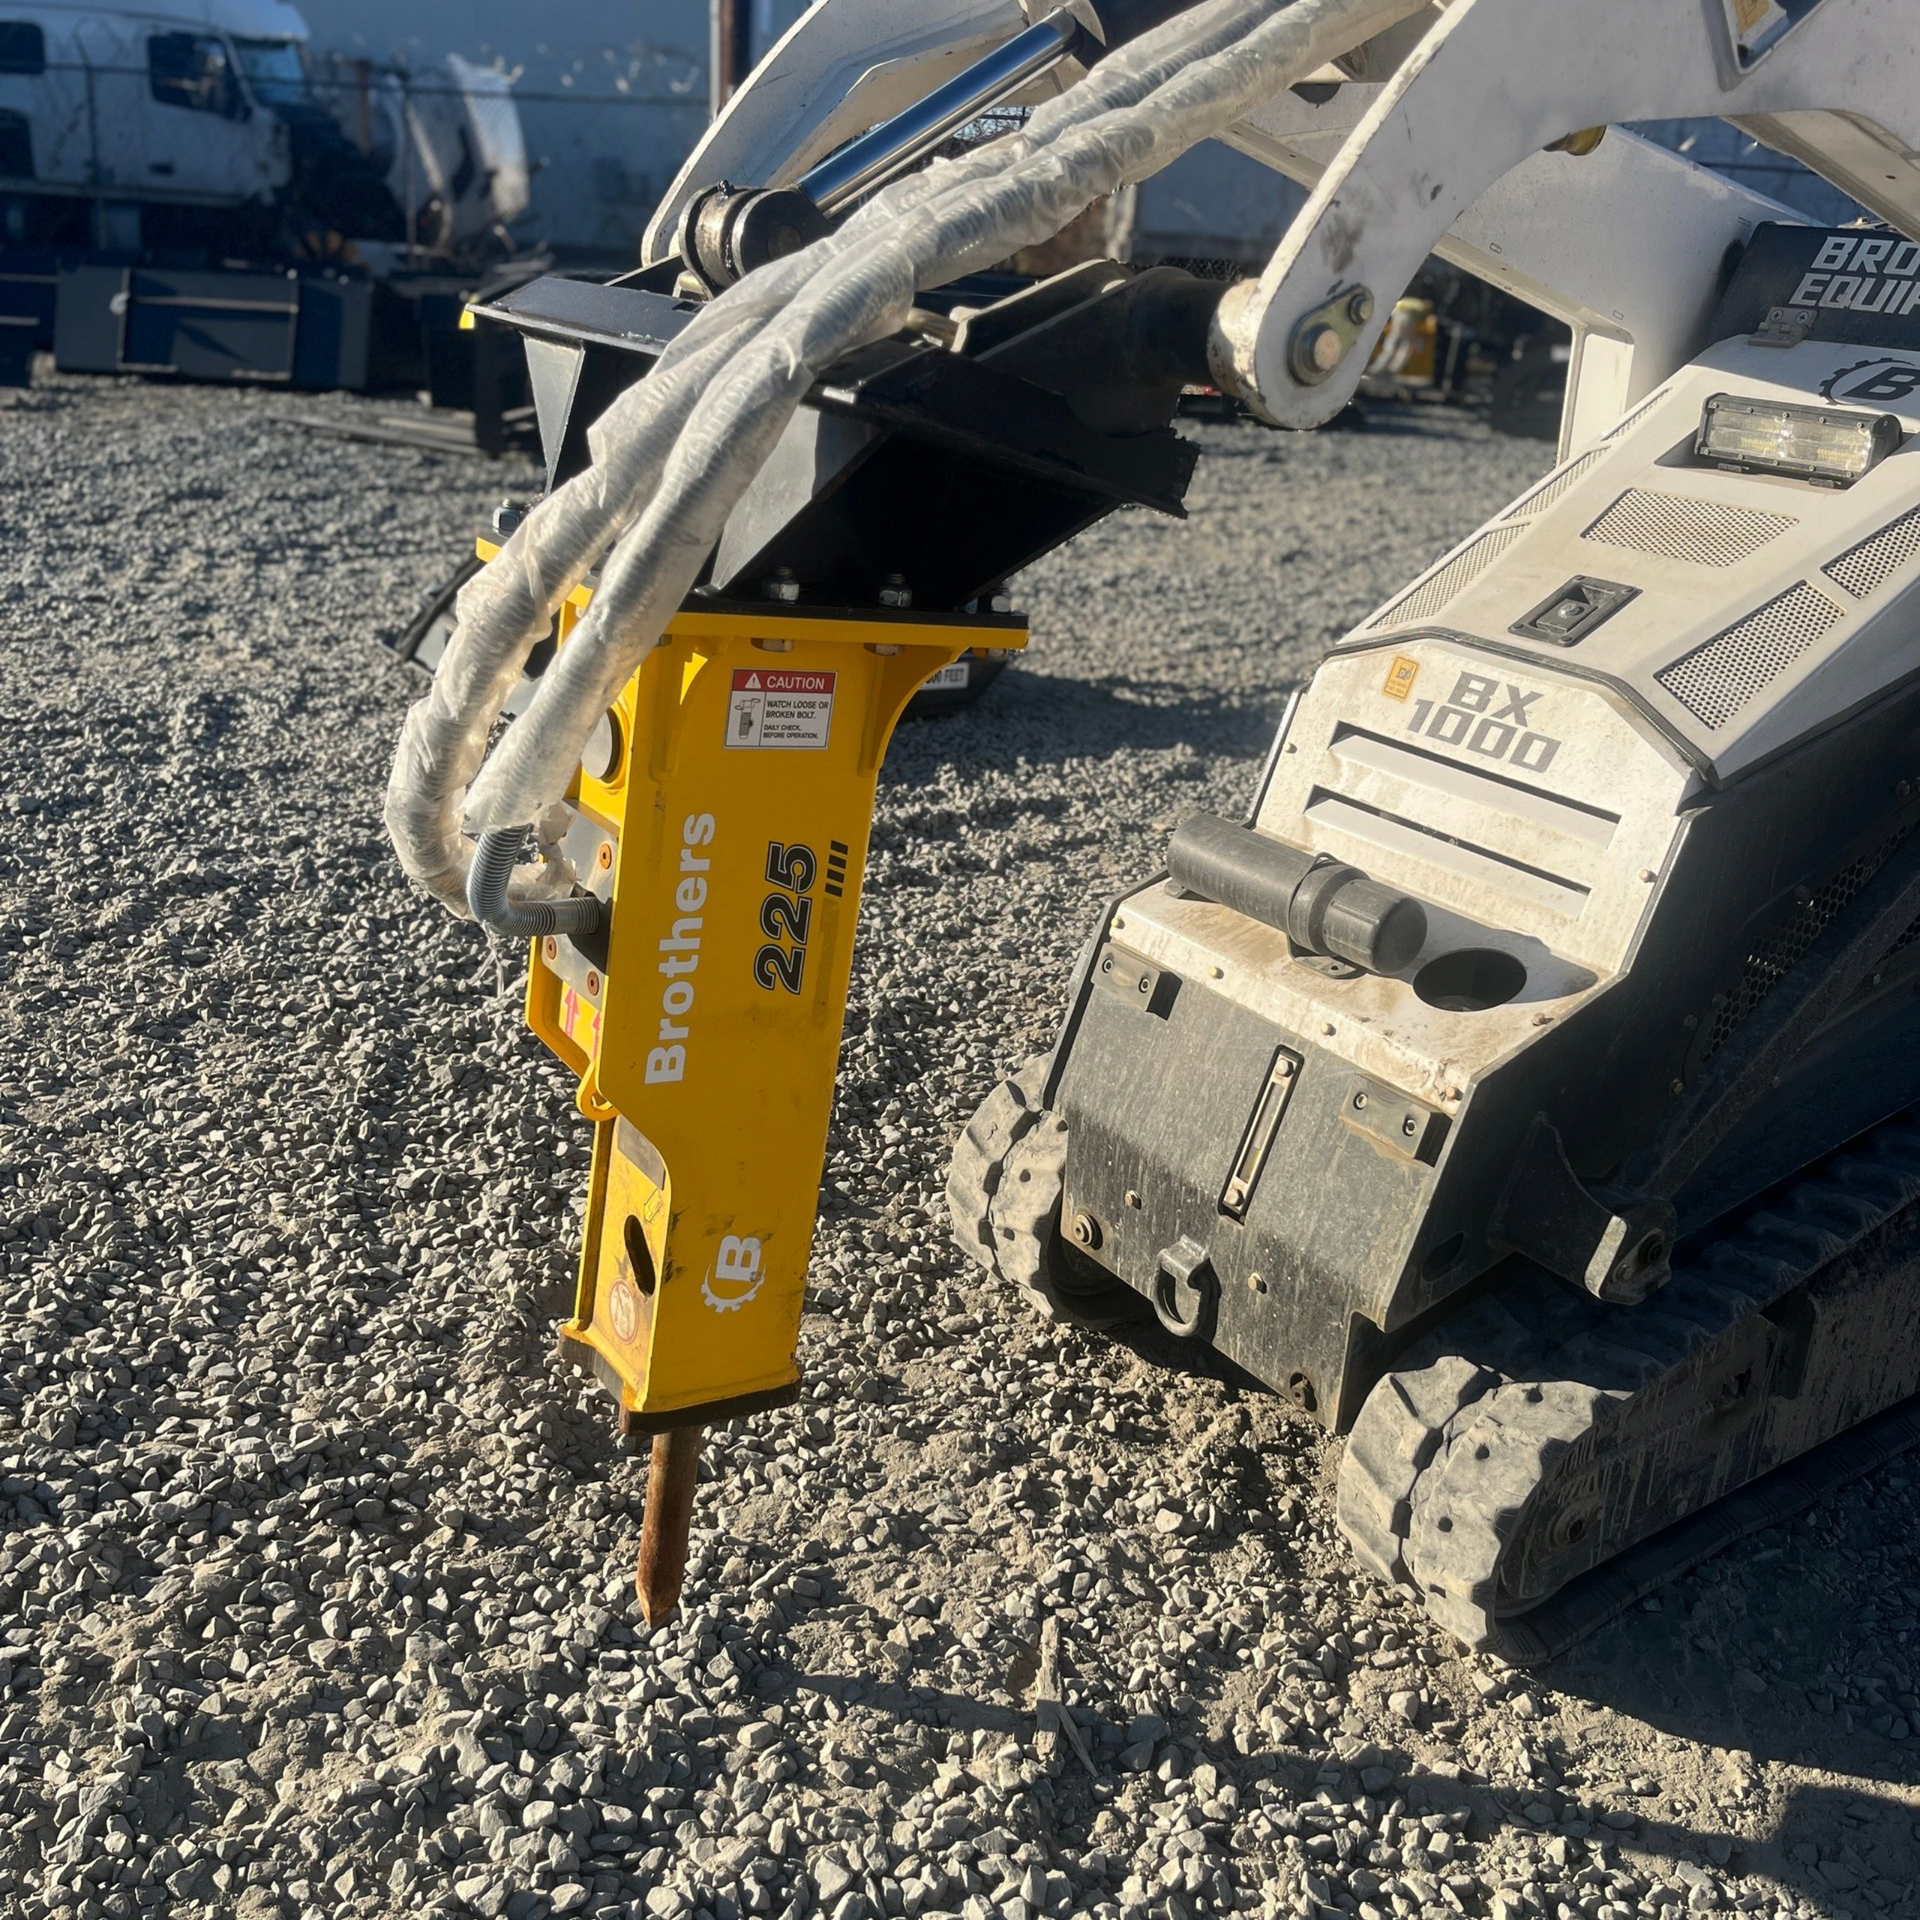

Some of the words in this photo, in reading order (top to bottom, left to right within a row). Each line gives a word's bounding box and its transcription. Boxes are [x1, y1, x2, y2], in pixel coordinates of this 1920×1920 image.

[1811, 236, 1920, 276] BRO
[766, 675, 825, 690] CAUTION
[944, 669, 965, 683] FEET
[765, 710, 795, 719] BROKEN
[796, 711, 817, 720] BOLT.
[766, 700, 792, 709] WATCH
[793, 701, 817, 709] LOOSE
[818, 701, 829, 709] OR
[1447, 671, 1544, 727] BX
[1407, 699, 1562, 774] 1000
[753, 840, 817, 996] 225
[644, 812, 716, 1085] Brothers
[715, 1235, 761, 1282] B
